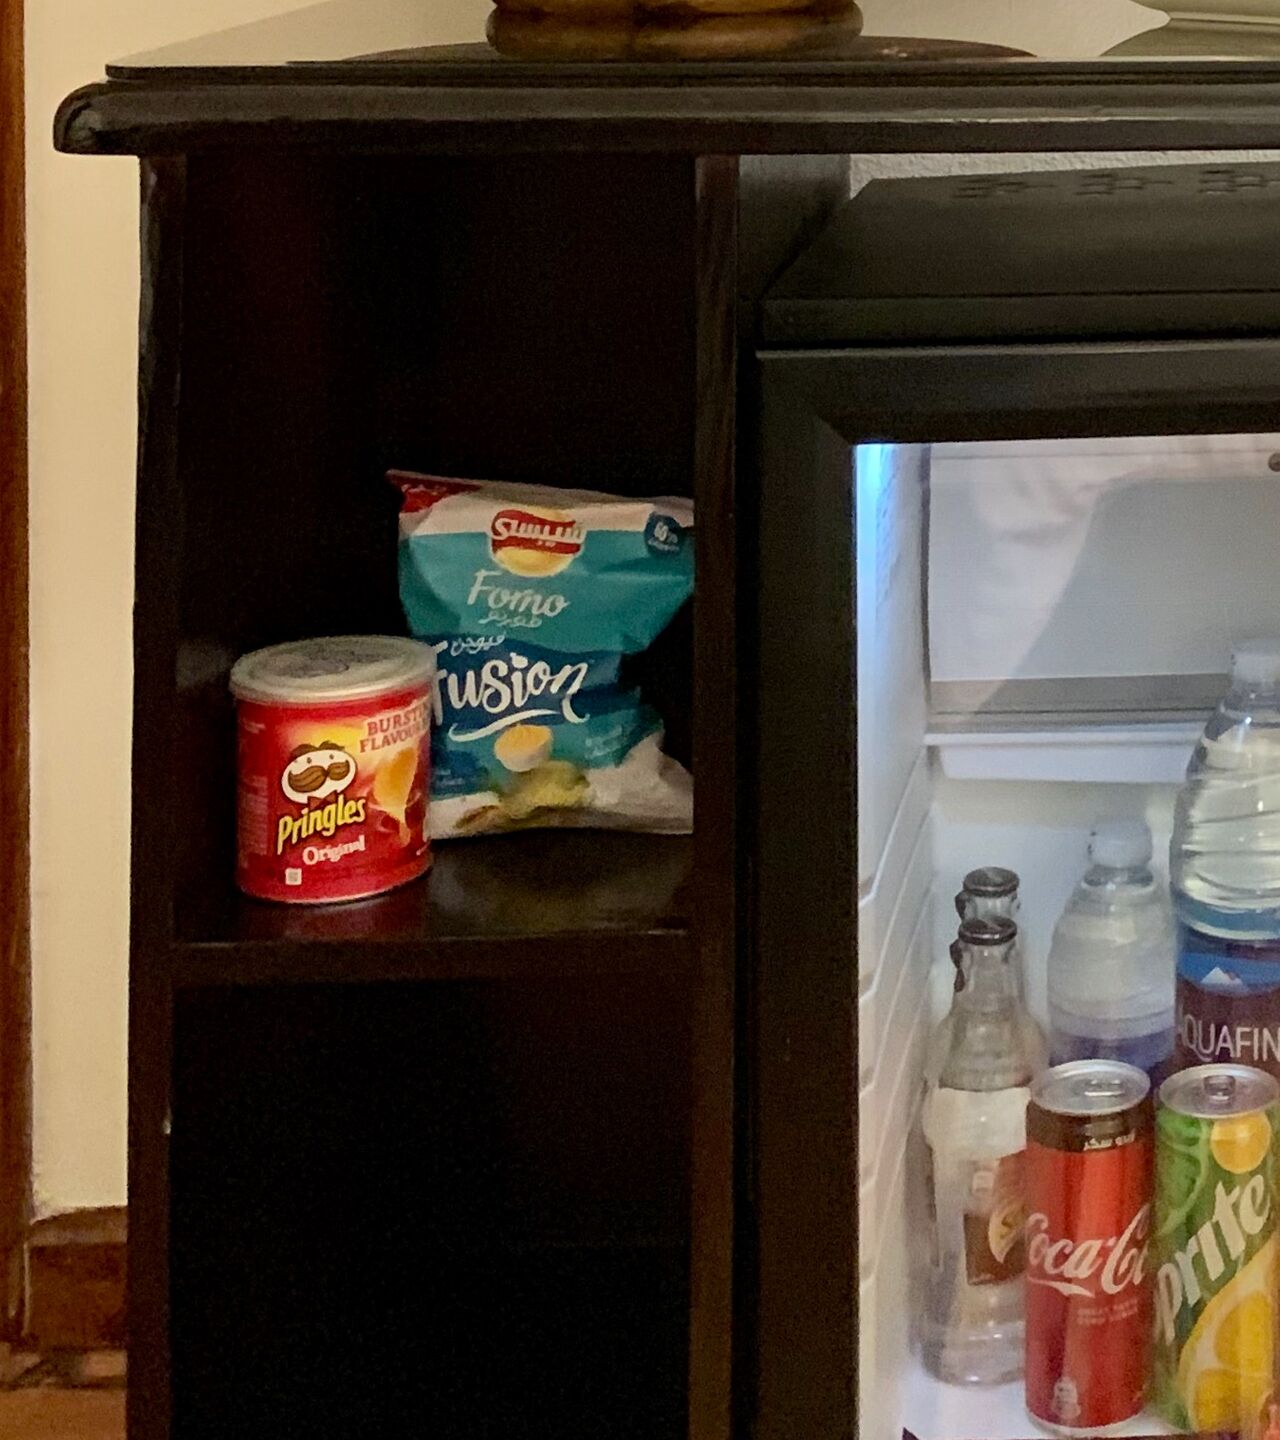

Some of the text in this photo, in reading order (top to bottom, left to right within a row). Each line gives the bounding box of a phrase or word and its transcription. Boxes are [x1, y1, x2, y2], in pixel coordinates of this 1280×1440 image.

[276, 794, 366, 856] Pringles
[303, 835, 366, 866] Original
[1154, 1173, 1271, 1347] prite
